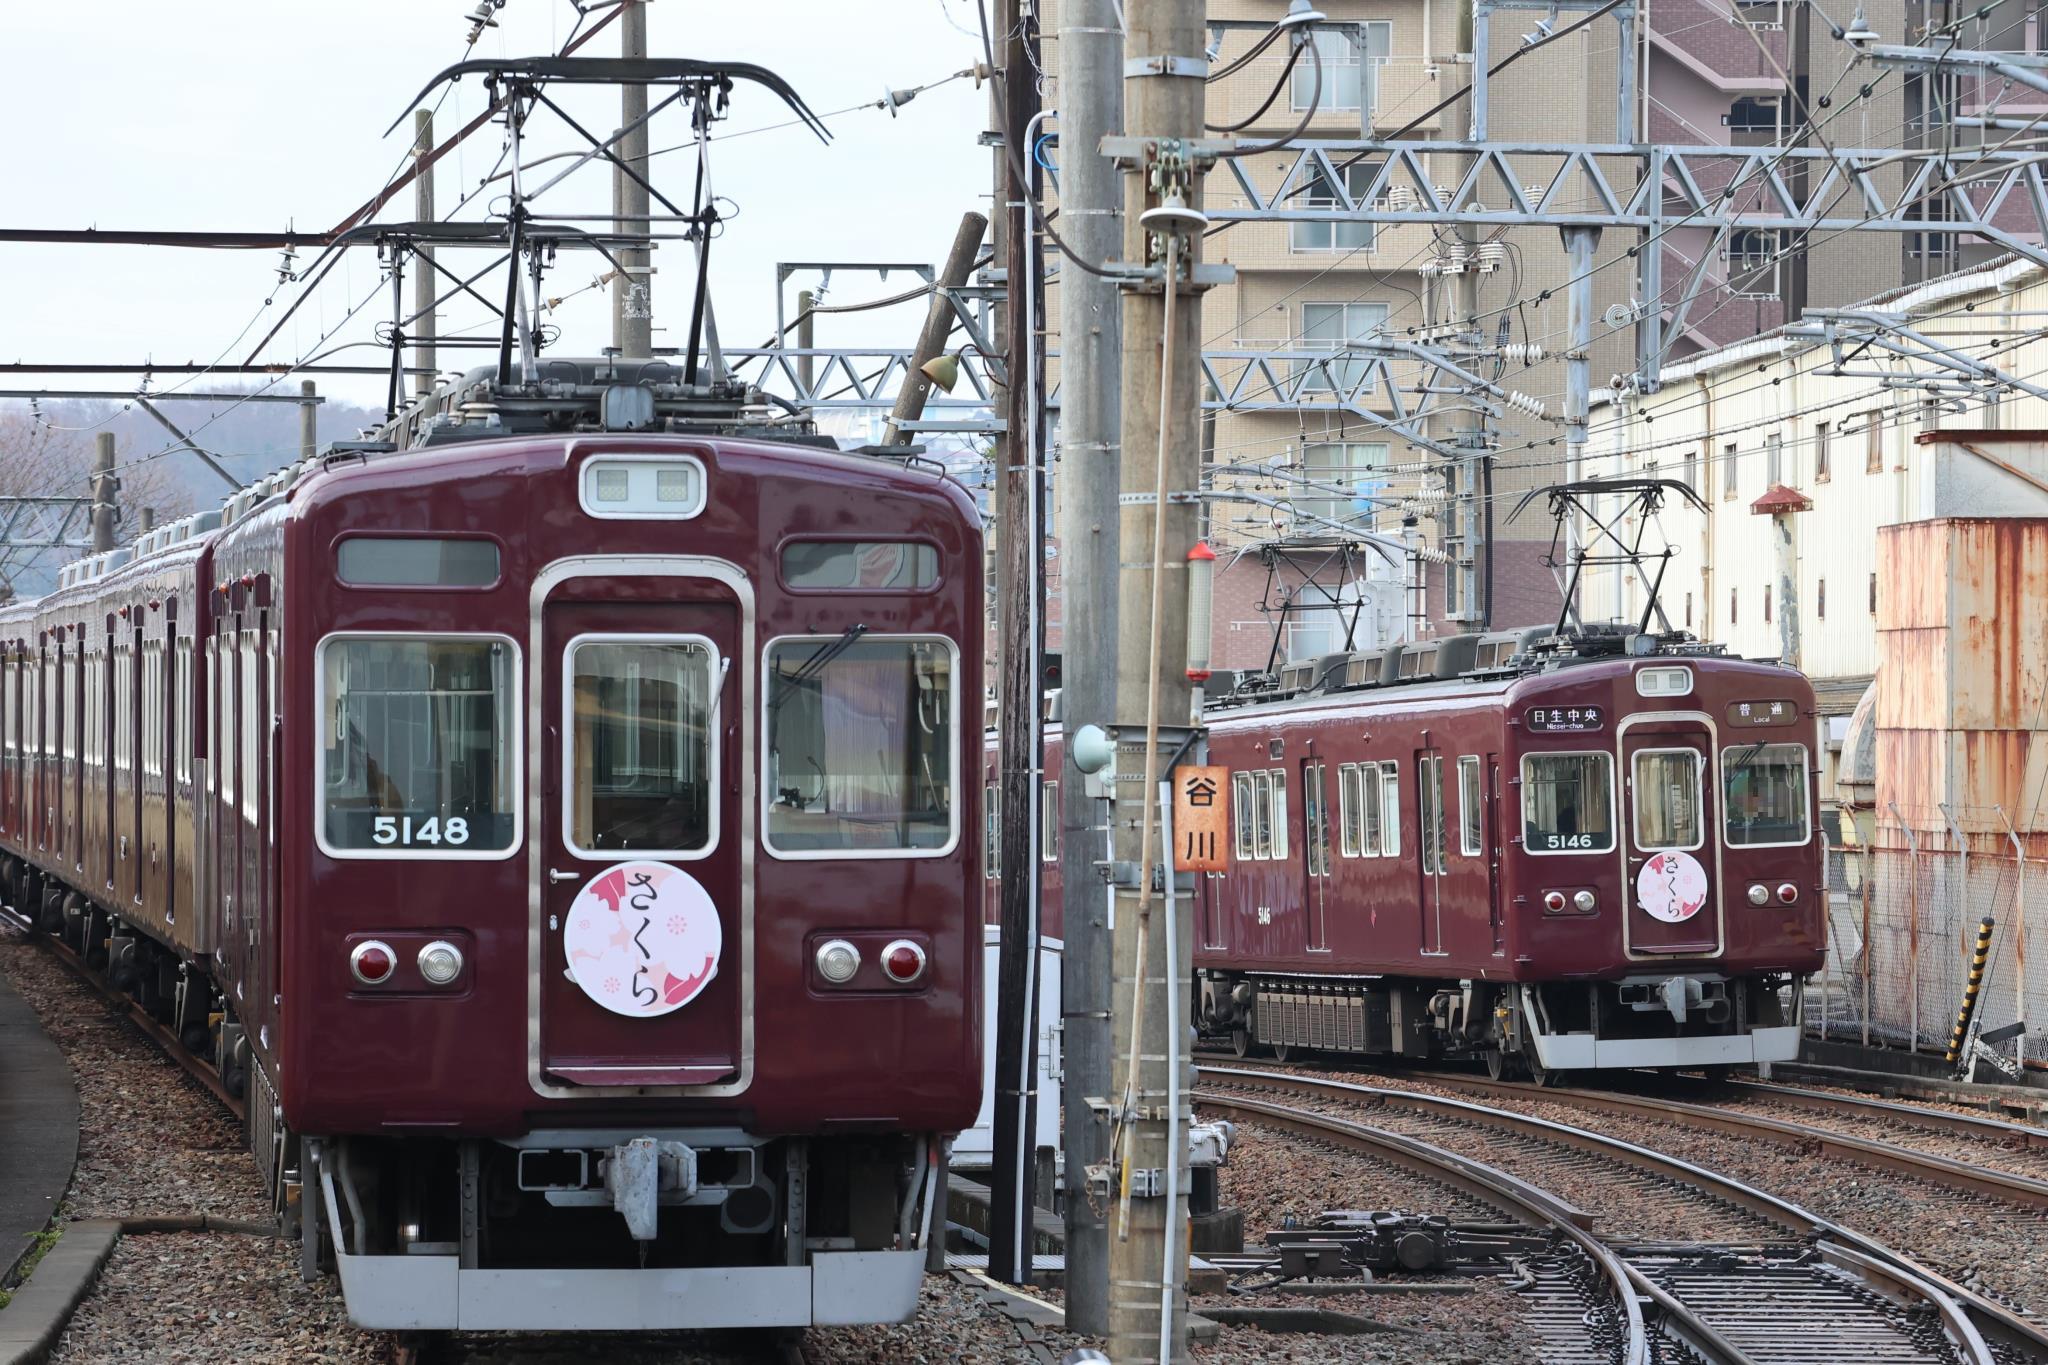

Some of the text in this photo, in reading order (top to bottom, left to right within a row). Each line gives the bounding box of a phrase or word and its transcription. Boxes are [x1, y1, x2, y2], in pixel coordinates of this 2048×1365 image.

[1534, 708, 1598, 723] 日生中央
[1739, 702, 1783, 717] 普通
[372, 816, 470, 845] 5148
[1186, 777, 1217, 861] 谷川
[1547, 834, 1592, 849] 5146
[1665, 856, 1680, 918] さくら
[1257, 906, 1271, 925] 5146
[627, 872, 659, 1007] さくら
